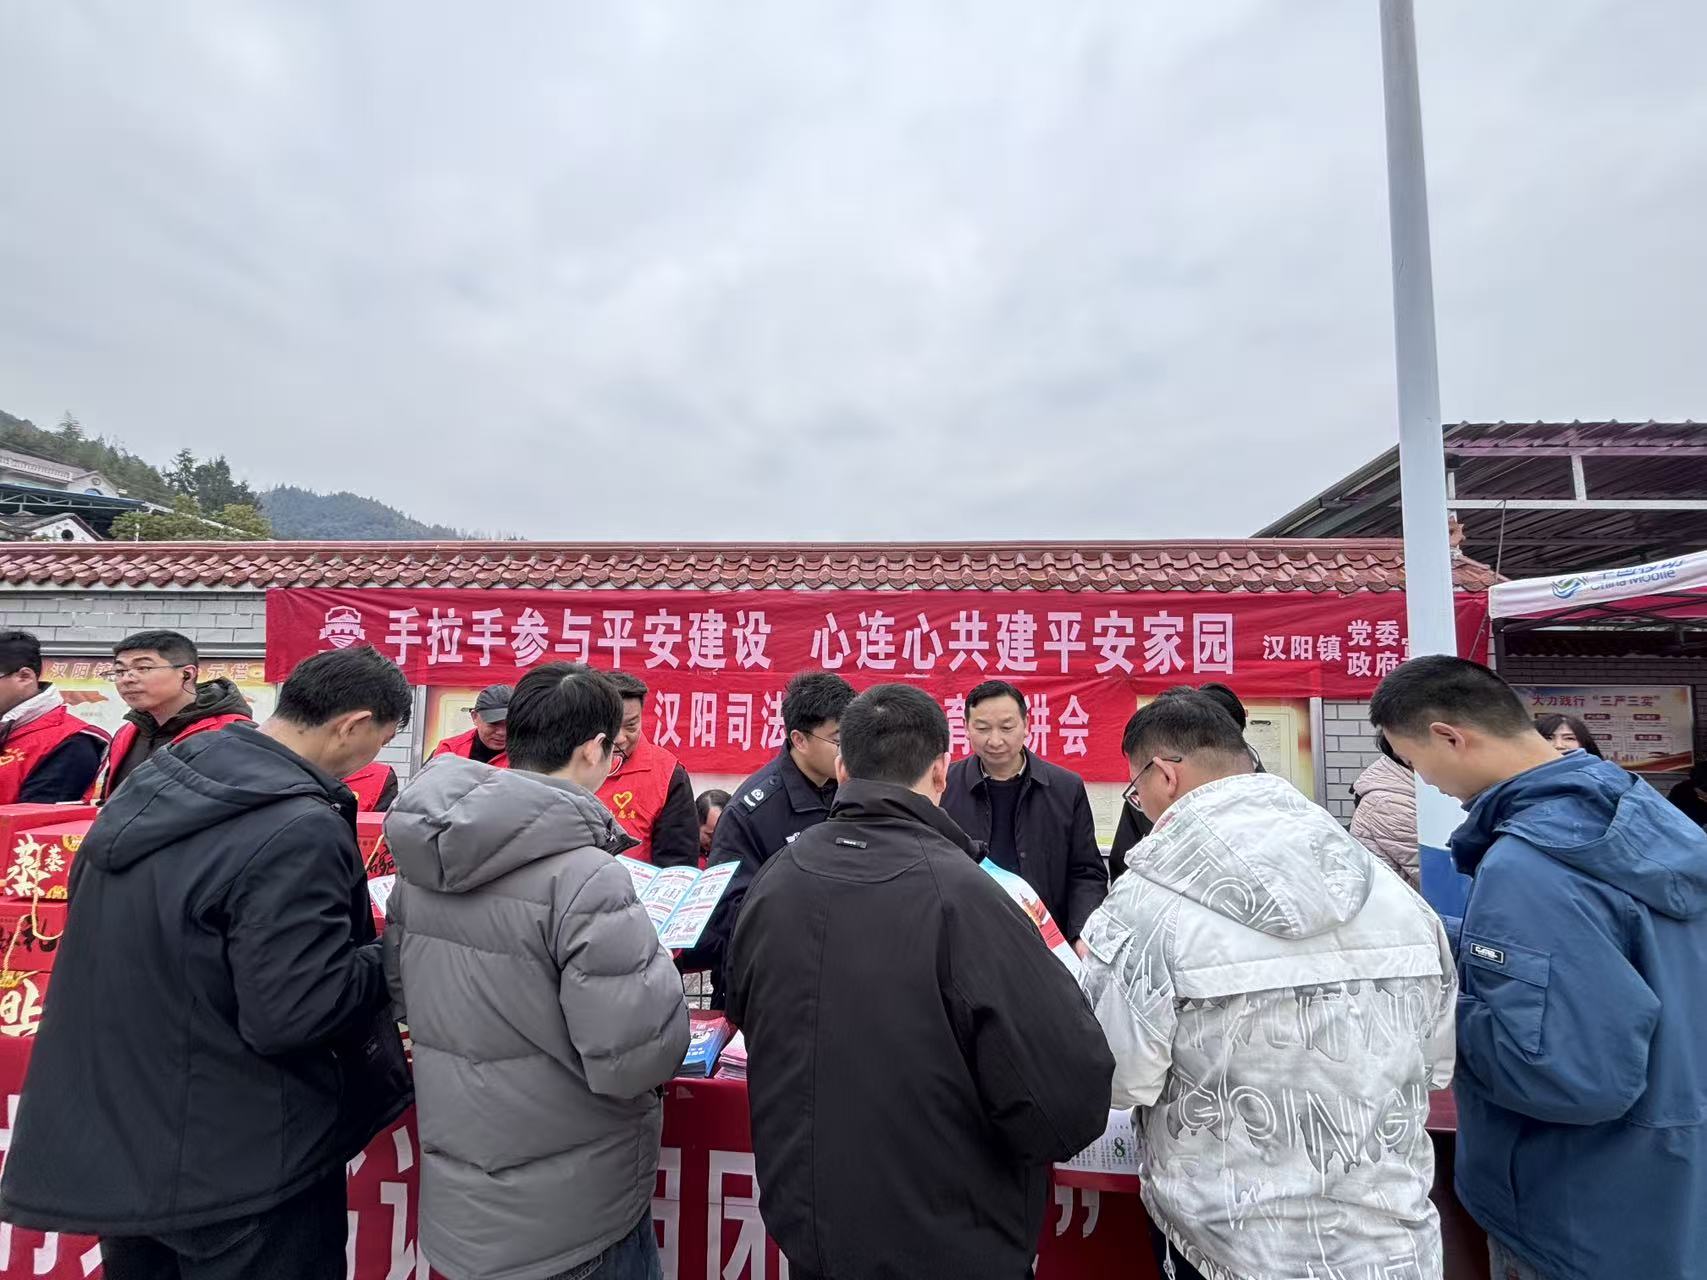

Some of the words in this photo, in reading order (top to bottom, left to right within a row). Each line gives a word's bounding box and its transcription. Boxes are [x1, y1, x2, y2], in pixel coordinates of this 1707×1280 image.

[384, 607, 773, 670] 手拉手参与平安建设
[809, 610, 1235, 676] 心连心共建平安家园
[1347, 619, 1399, 647] 党委
[1262, 634, 1342, 662] 汉阳镇
[1346, 651, 1400, 677] 政府
[1114, 1136, 1126, 1158] 8
